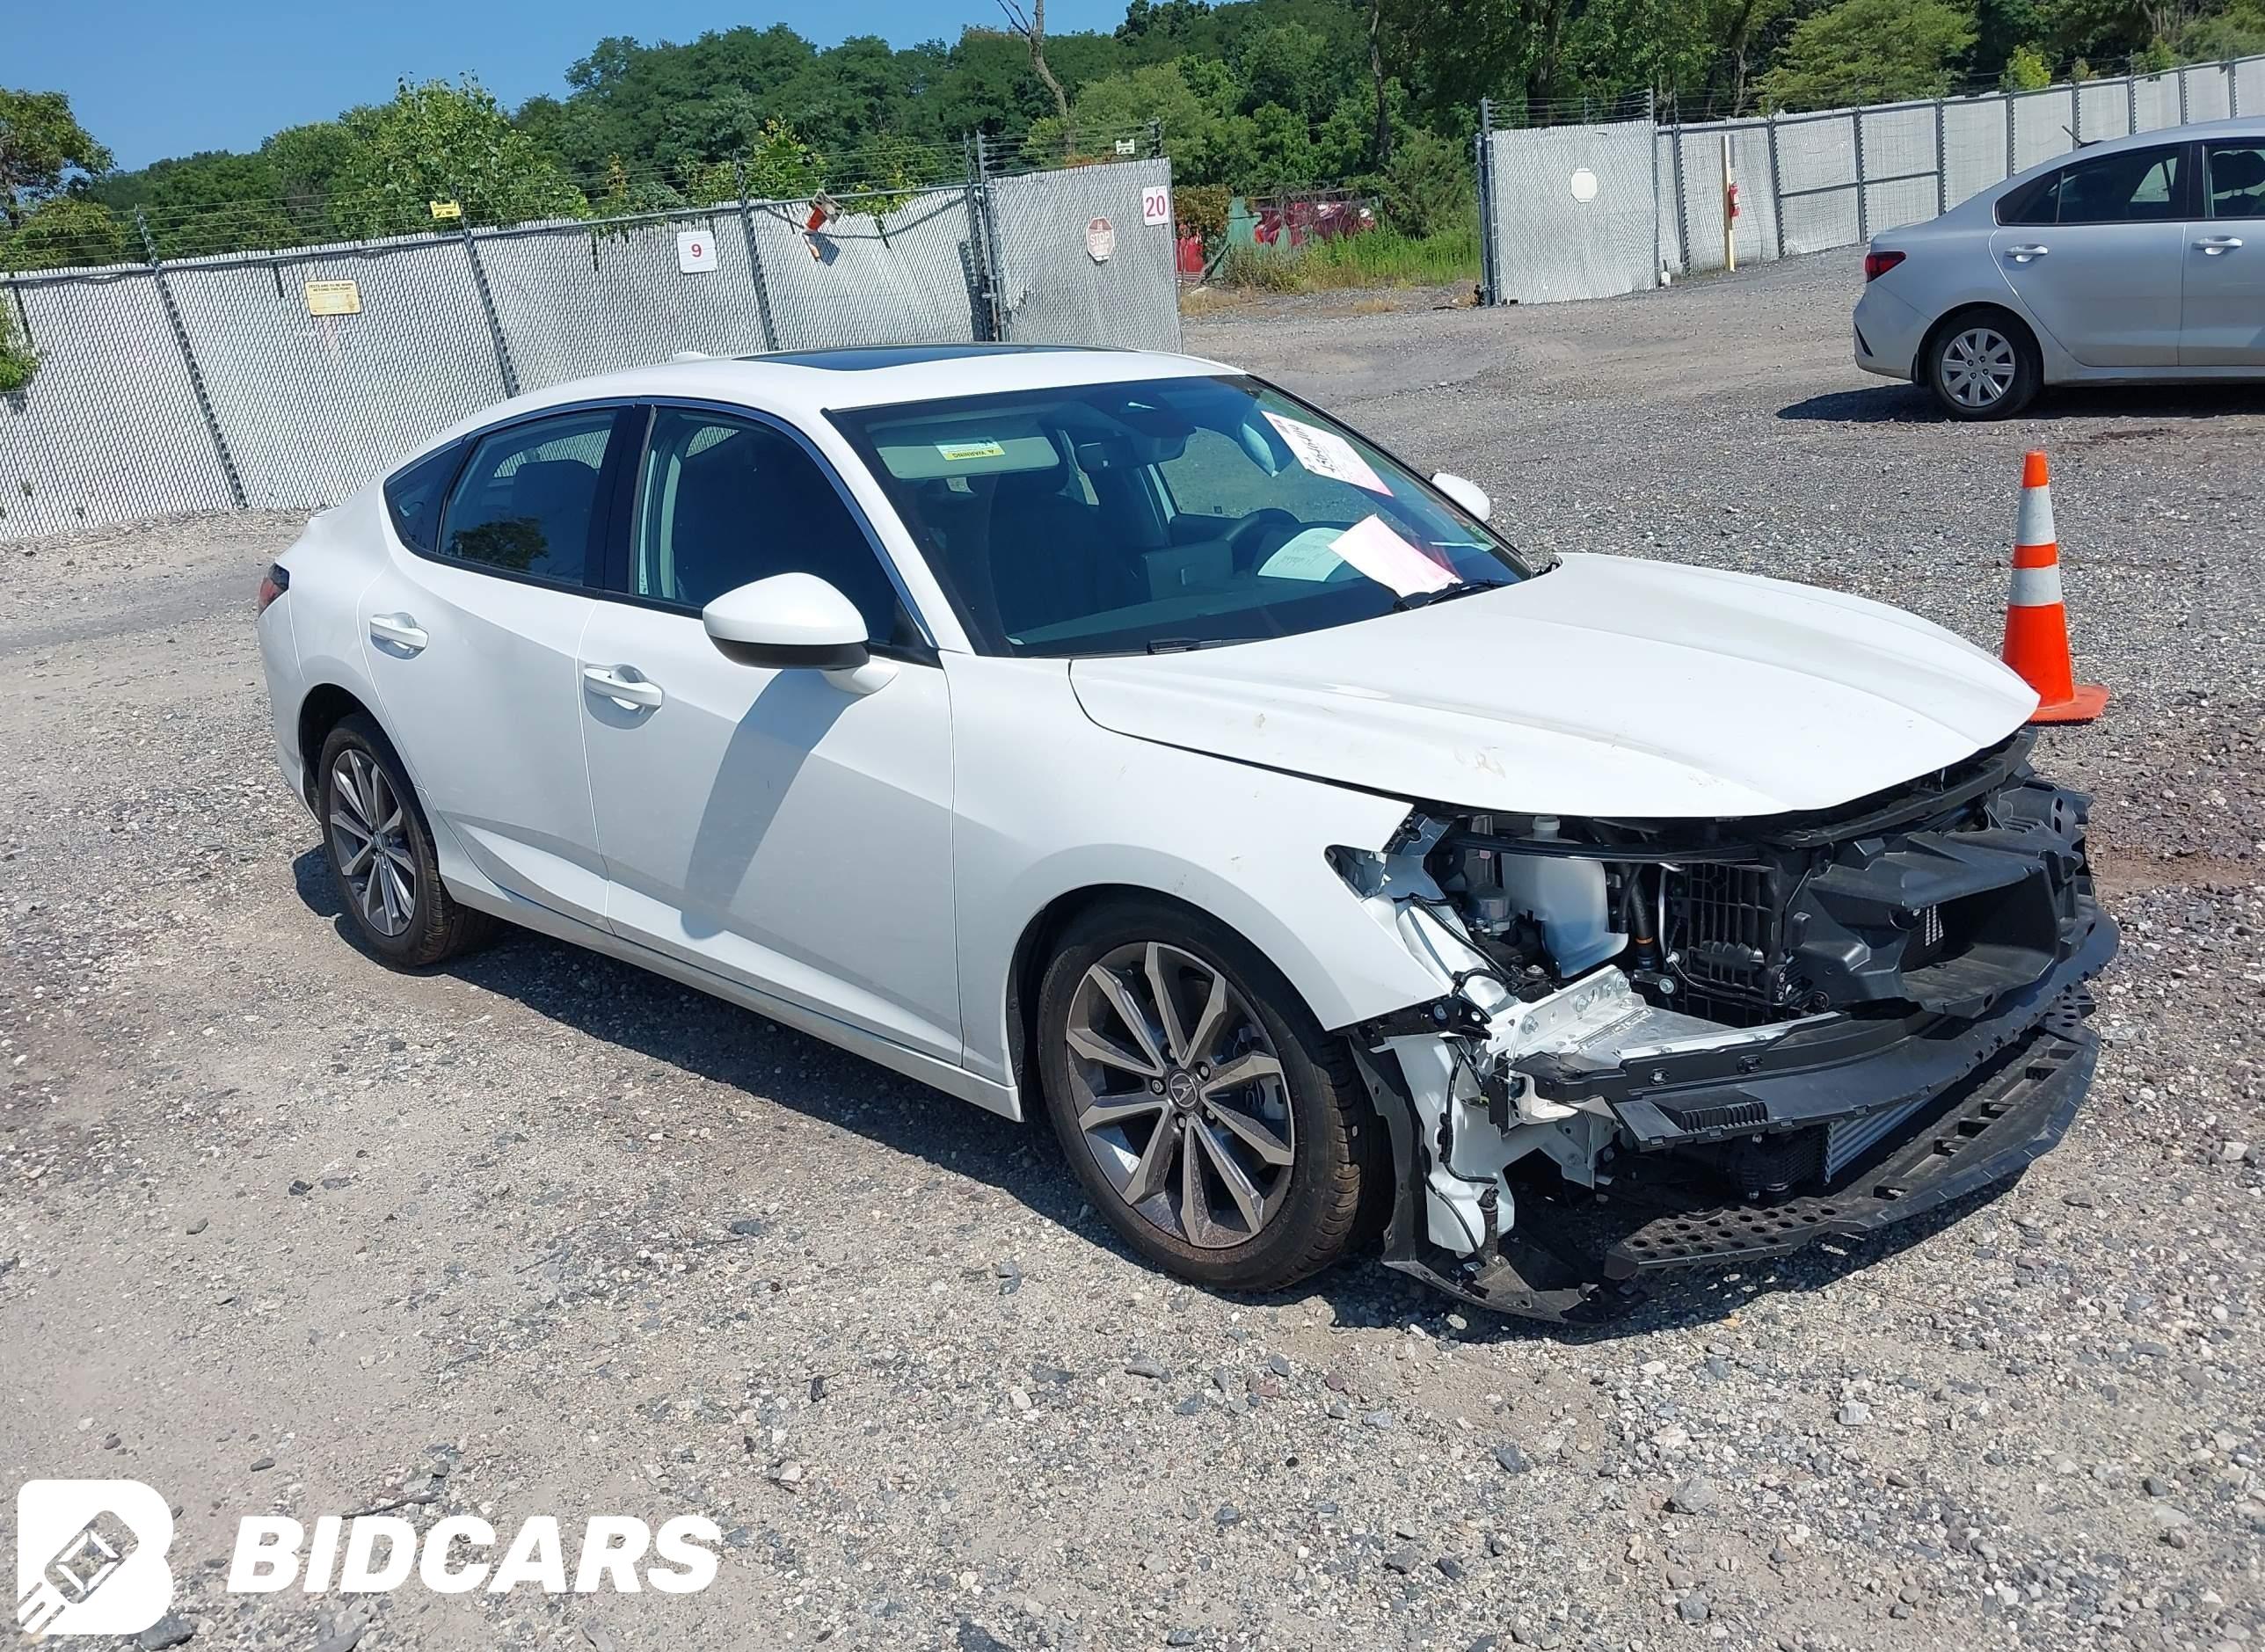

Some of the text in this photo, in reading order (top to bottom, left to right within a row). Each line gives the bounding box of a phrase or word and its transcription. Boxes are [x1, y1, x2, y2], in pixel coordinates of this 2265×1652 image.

[1145, 194, 1166, 217] 20
[1090, 231, 1110, 245] STOP
[691, 243, 702, 258] 9
